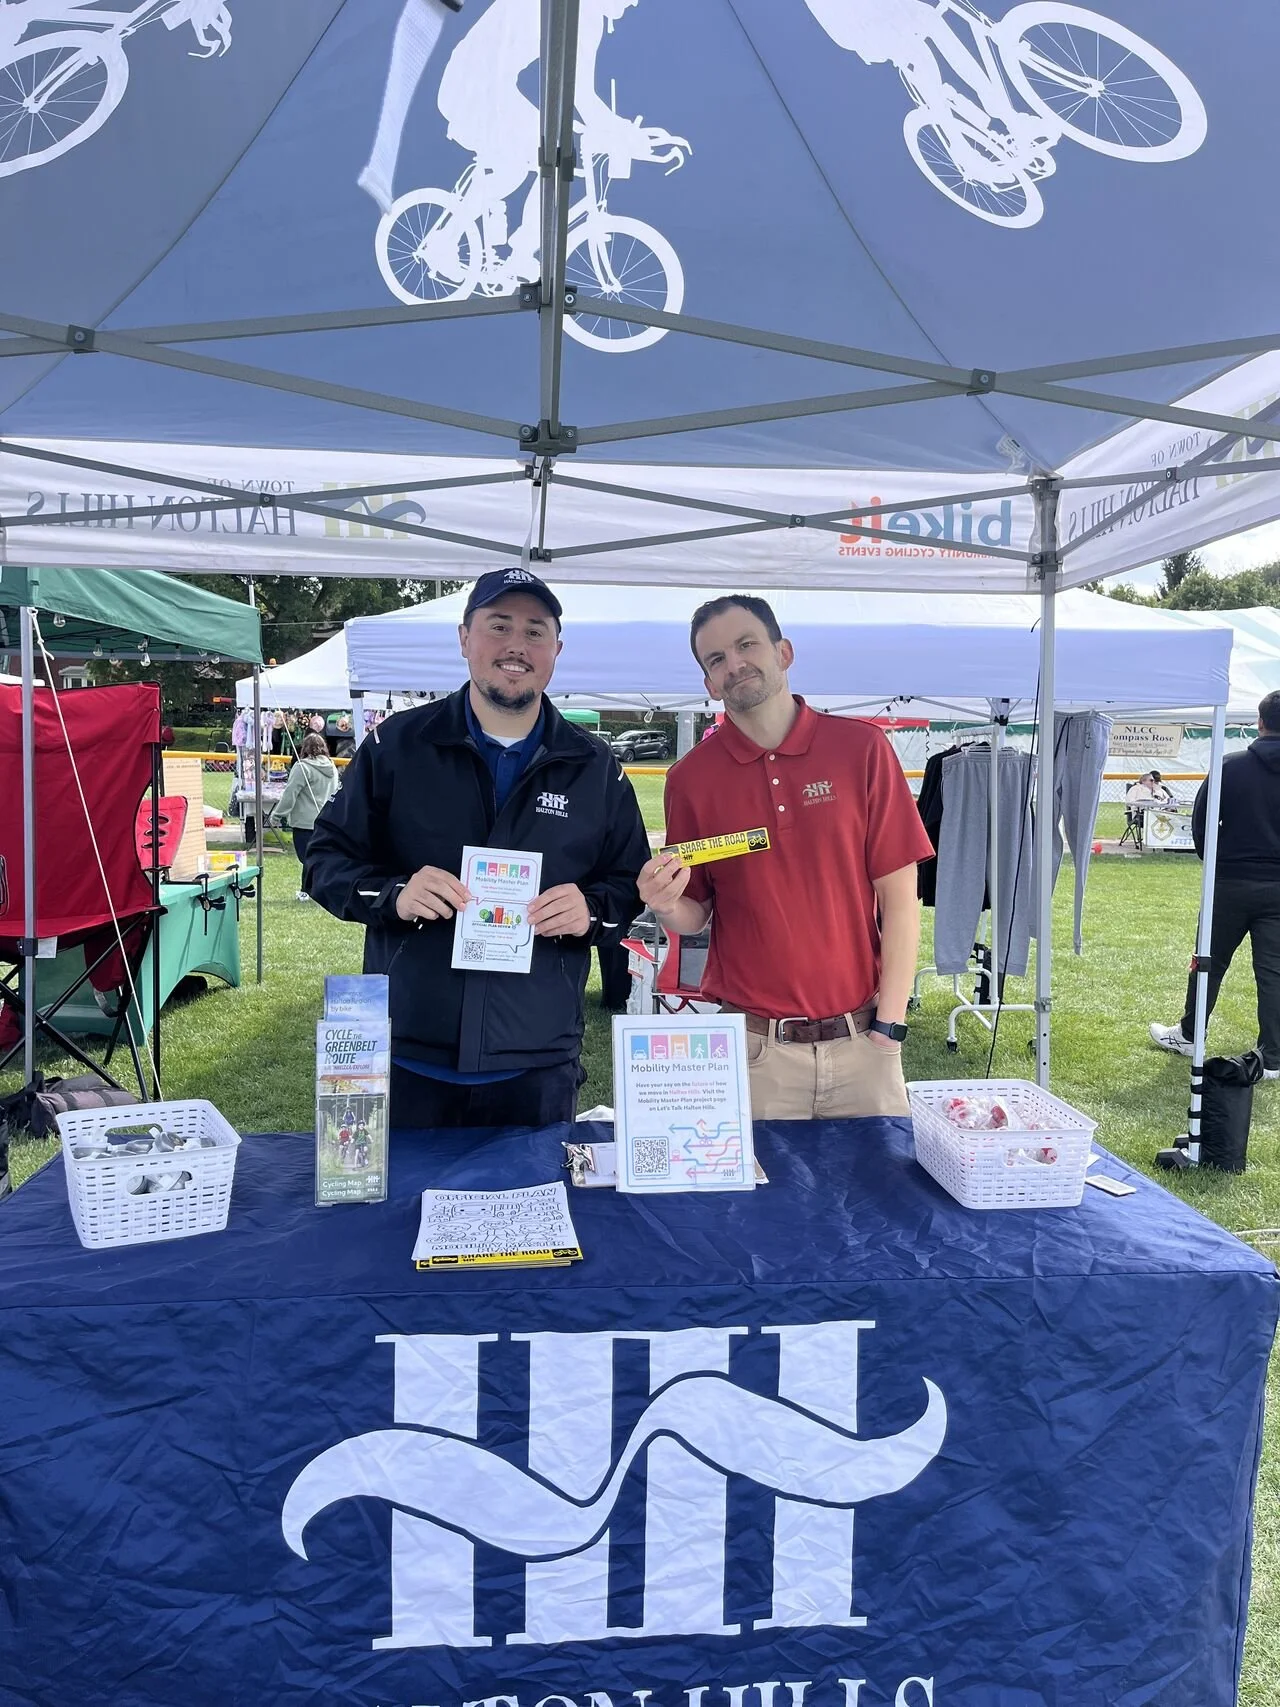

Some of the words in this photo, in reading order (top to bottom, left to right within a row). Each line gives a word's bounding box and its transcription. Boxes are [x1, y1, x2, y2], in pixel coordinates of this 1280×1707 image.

[1125, 726, 1157, 734] NLCC
[1111, 733, 1149, 742] ompass
[1152, 734, 1174, 742] Rose
[680, 839, 707, 854] SHARE
[708, 837, 723, 849] THE
[724, 832, 746, 846] ROAD
[325, 1029, 353, 1041] CYCLE
[325, 1040, 378, 1053] GREENBELT
[325, 1052, 357, 1065] ROUTE
[631, 1064, 670, 1074] Mobility
[672, 1063, 706, 1072] Master
[708, 1062, 729, 1072] Plan
[322, 1180, 346, 1188] Cycling
